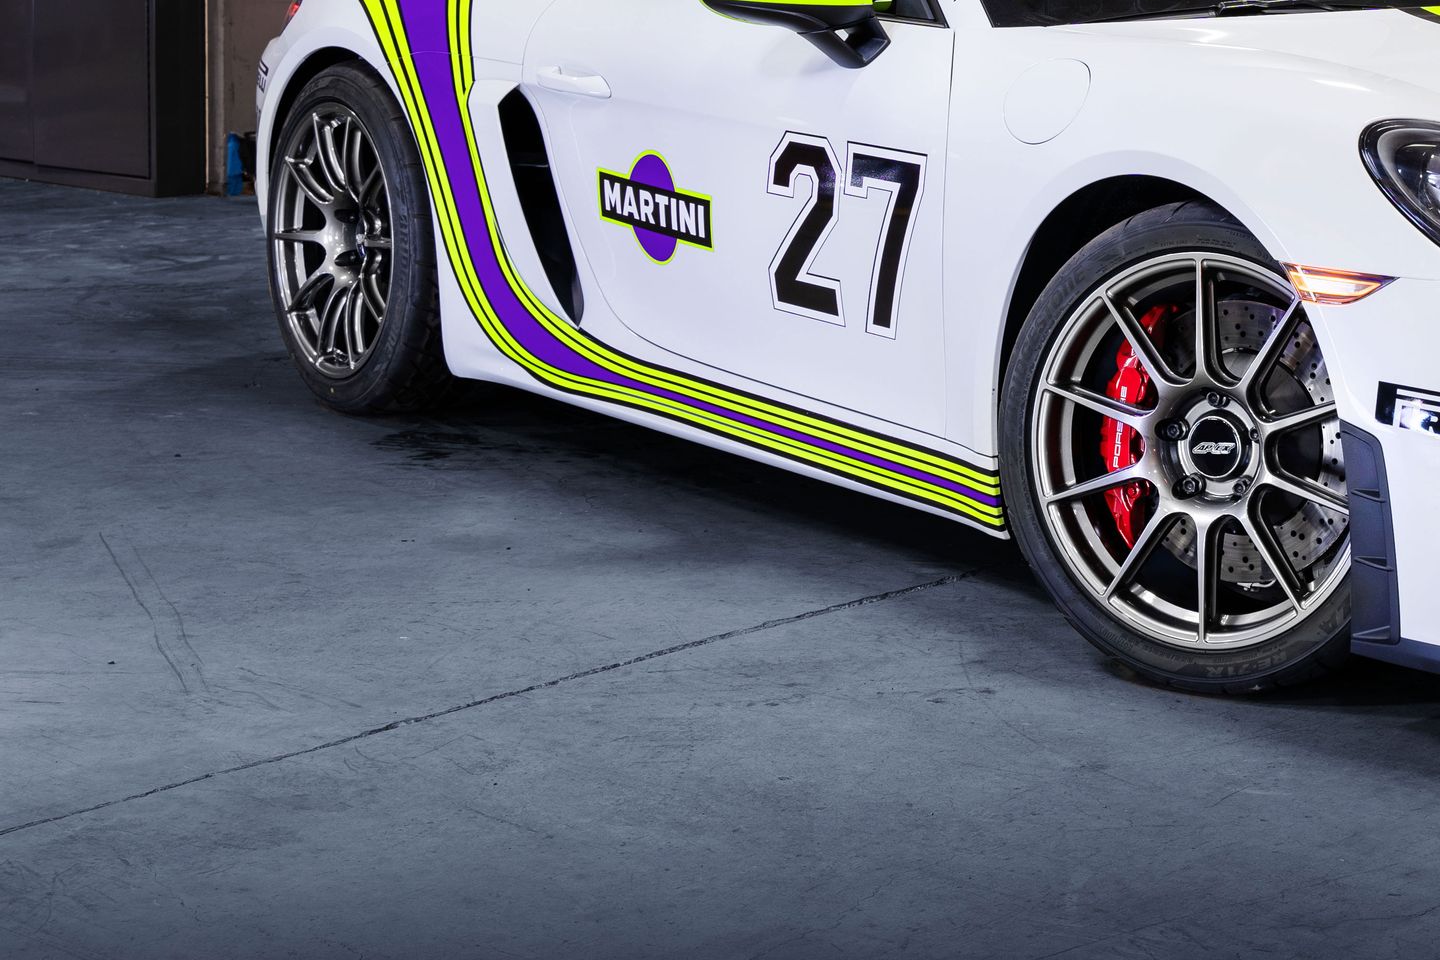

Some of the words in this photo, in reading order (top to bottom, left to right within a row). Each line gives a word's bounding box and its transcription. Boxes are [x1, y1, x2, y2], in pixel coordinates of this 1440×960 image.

[603, 178, 706, 239] MARTINI
[767, 130, 928, 340] 27
[1113, 385, 1128, 468] PORSE
